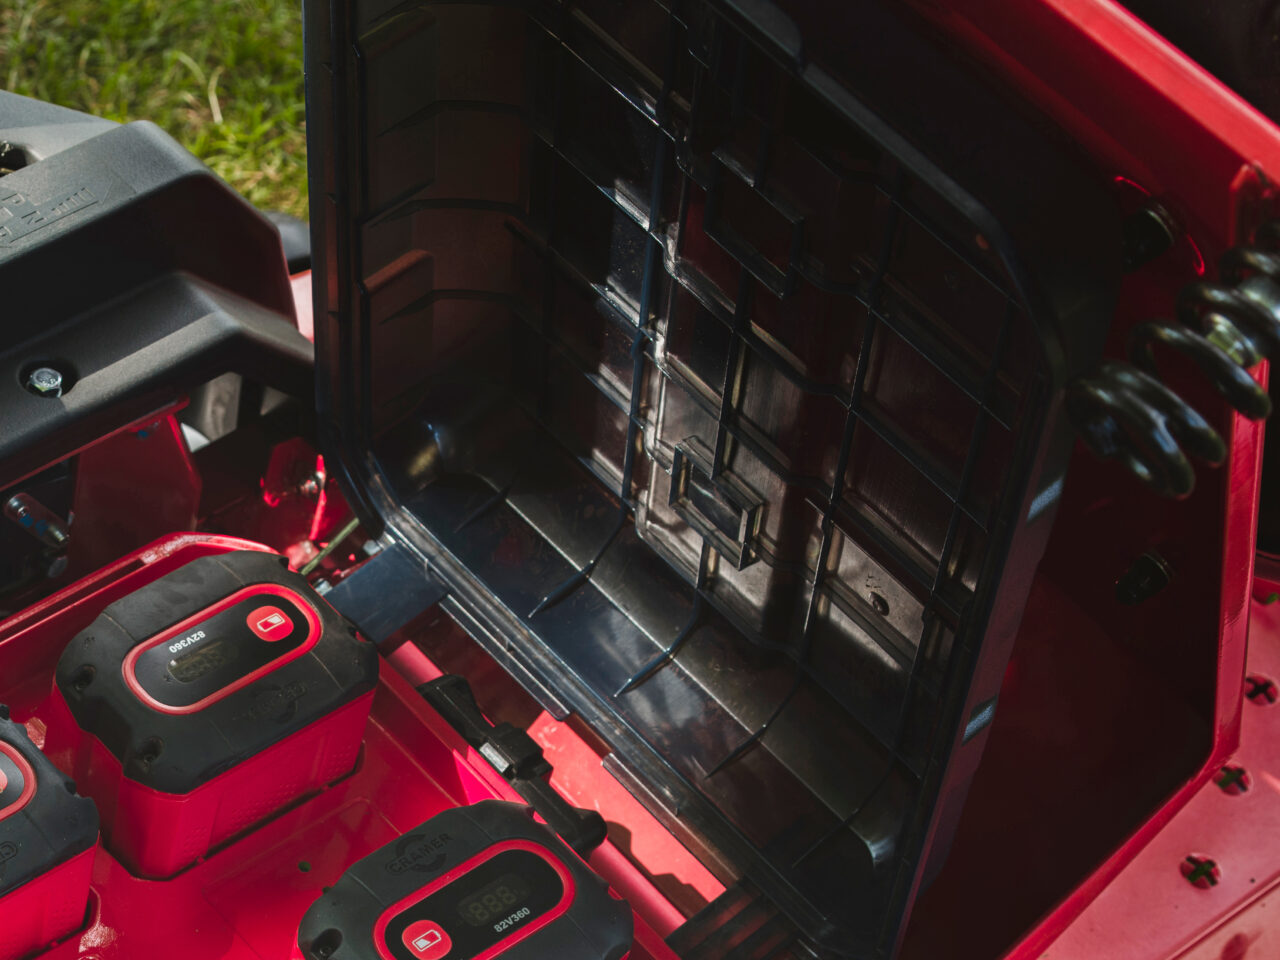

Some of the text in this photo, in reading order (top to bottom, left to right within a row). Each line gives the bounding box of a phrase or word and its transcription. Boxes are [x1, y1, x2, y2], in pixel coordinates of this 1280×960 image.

[168, 630, 206, 653] 82V360
[388, 833, 455, 873] CRAMER
[493, 907, 531, 932] 82V360
